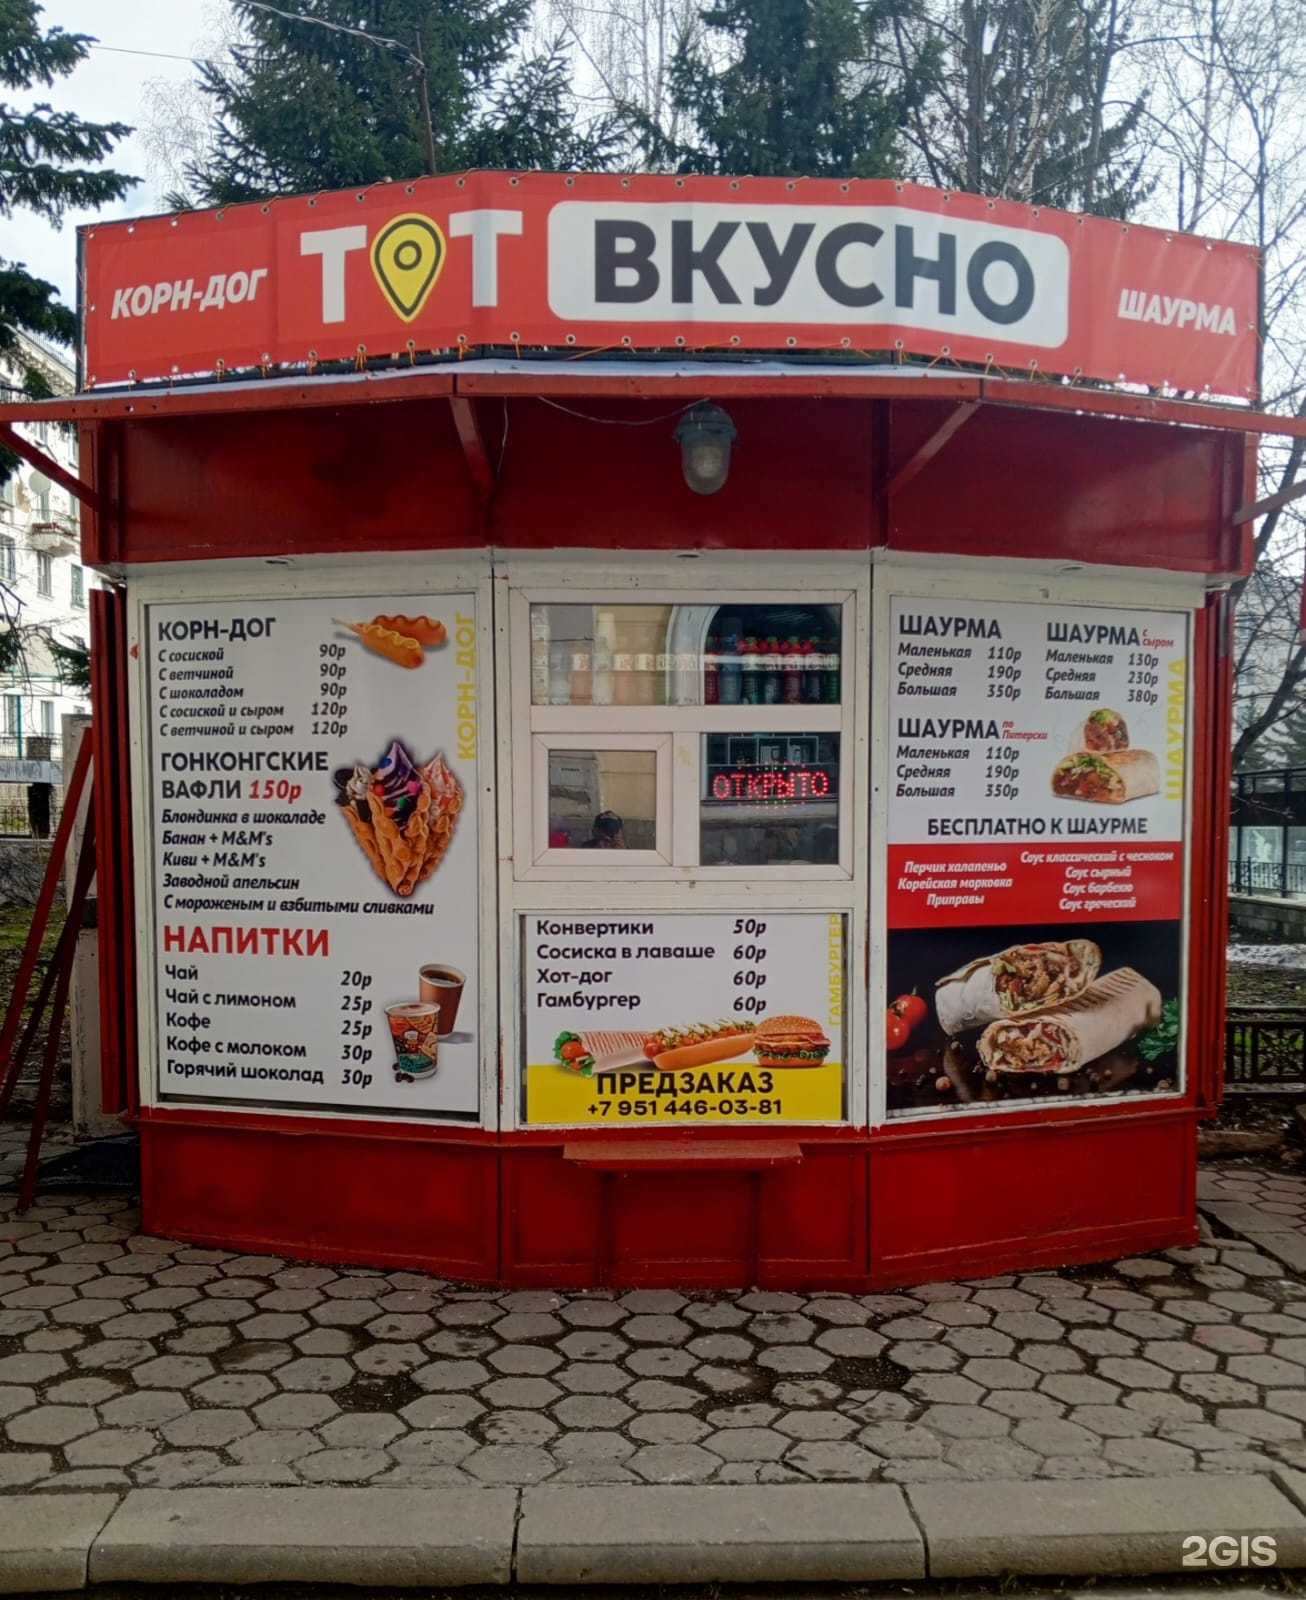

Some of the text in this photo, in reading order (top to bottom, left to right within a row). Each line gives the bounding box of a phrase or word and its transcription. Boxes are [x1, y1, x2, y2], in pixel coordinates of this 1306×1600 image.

[594, 219, 1036, 326] ВКУСНО
[111, 268, 268, 320] КОРН-ДОГ
[1117, 288, 1237, 336] ШАУРМА
[158, 617, 276, 641] КОРН-ДОГ
[899, 614, 1002, 639] ШАУРМА
[1047, 622, 1140, 646] ШАУРМА
[158, 649, 224, 662] С сосиской
[319, 644, 346, 659] 90р
[898, 643, 972, 659] Маленькая
[987, 646, 1022, 661] 110р
[1046, 649, 1113, 665] Маленькая
[1128, 652, 1159, 668] 130р
[158, 667, 233, 681] С ветчиной
[320, 664, 347, 678] 90р
[898, 662, 952, 678] Средняя
[987, 665, 1022, 680] 190р
[1046, 668, 1096, 683] Средняя
[456, 610, 478, 760] КОРН-ДОГ
[1128, 671, 1159, 687] 230р
[159, 686, 243, 699] С шоколадом
[320, 683, 347, 697] 90р
[897, 682, 957, 697] Большая
[987, 685, 1021, 700] 350р
[1045, 687, 1100, 701] Большая
[1128, 689, 1158, 704] 380р
[159, 705, 284, 719] С сосиской и сыром
[311, 703, 348, 717] 120р
[160, 723, 293, 738] С ветчиной и сыром
[312, 722, 348, 736] 120р
[898, 718, 1000, 740] ШАУРМА
[896, 745, 969, 760] Маленькая
[985, 746, 1020, 761] 110р
[161, 752, 329, 772] ГОНКОНГСКИЕ
[896, 765, 951, 780] Средняя
[985, 765, 1019, 780] 190р
[162, 780, 303, 804] ВАФЛИ 150р
[713, 771, 829, 799] ОТКРЫТО
[896, 783, 955, 798] Большая
[985, 783, 1019, 799] 350р
[162, 809, 326, 825] Блондинка в шоколаде
[928, 817, 1148, 836] БЕСПЛАТНО К ШАУРМЕ
[162, 831, 206, 845] Банан
[162, 852, 197, 867] Киви
[1020, 851, 1044, 865] Соус
[904, 861, 1007, 876] Перчик халапеньо
[1065, 867, 1089, 880] Соус
[163, 873, 299, 890] Заводной апельсин
[897, 877, 1013, 892] Корейская морковка
[1063, 883, 1086, 896] Соус
[164, 895, 434, 915] С мороженым и взбитыми сливками
[926, 893, 985, 908] Приправы
[1059, 898, 1082, 912] Соус
[536, 920, 653, 939] Конвертики
[733, 919, 767, 938] 50р
[163, 925, 329, 957] НАПИТКИ
[536, 944, 715, 960] Сосиска в лаваше
[733, 945, 767, 963] 60р
[165, 965, 198, 980] Чай
[340, 971, 372, 989] 20р
[536, 968, 612, 986] Хот-дог
[733, 971, 767, 989] 60р
[165, 989, 297, 1008] Чай с лимоном
[340, 996, 372, 1014] 25р
[536, 991, 641, 1011] Гамбургер
[733, 997, 767, 1015] 60р
[166, 1013, 211, 1031] Кофе
[341, 1020, 372, 1039] 25р
[167, 1037, 307, 1058] Кофе с молоком
[341, 1045, 372, 1064] 30р
[167, 1060, 324, 1085] Горячий шоколад
[341, 1069, 372, 1088] 30р
[597, 1072, 774, 1097] ПРЕДЗАКАЗ
[588, 1099, 782, 1116] +7 951 446-03-81
